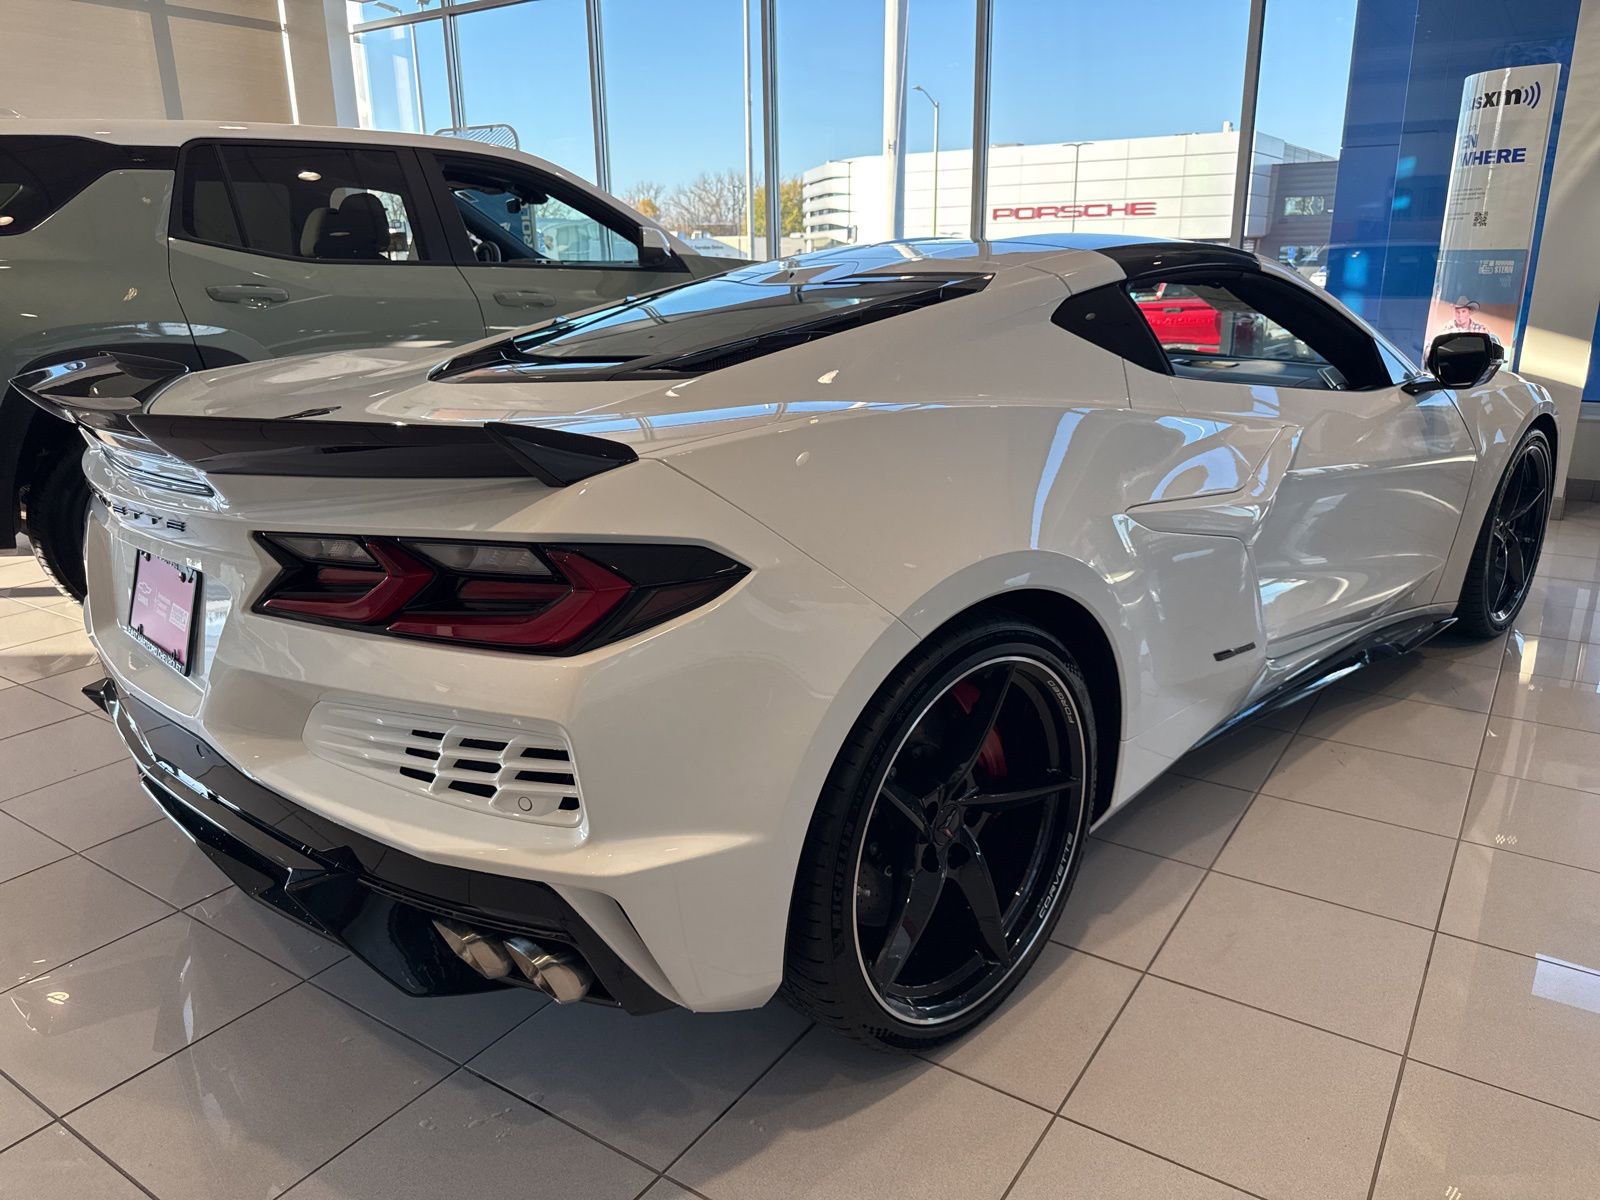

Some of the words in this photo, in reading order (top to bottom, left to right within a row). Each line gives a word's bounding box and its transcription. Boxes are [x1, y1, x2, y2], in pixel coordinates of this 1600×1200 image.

[992, 202, 1158, 221] PORSCHE
[1047, 680, 1075, 724] FORGED
[1038, 831, 1074, 919] CORVETTE
